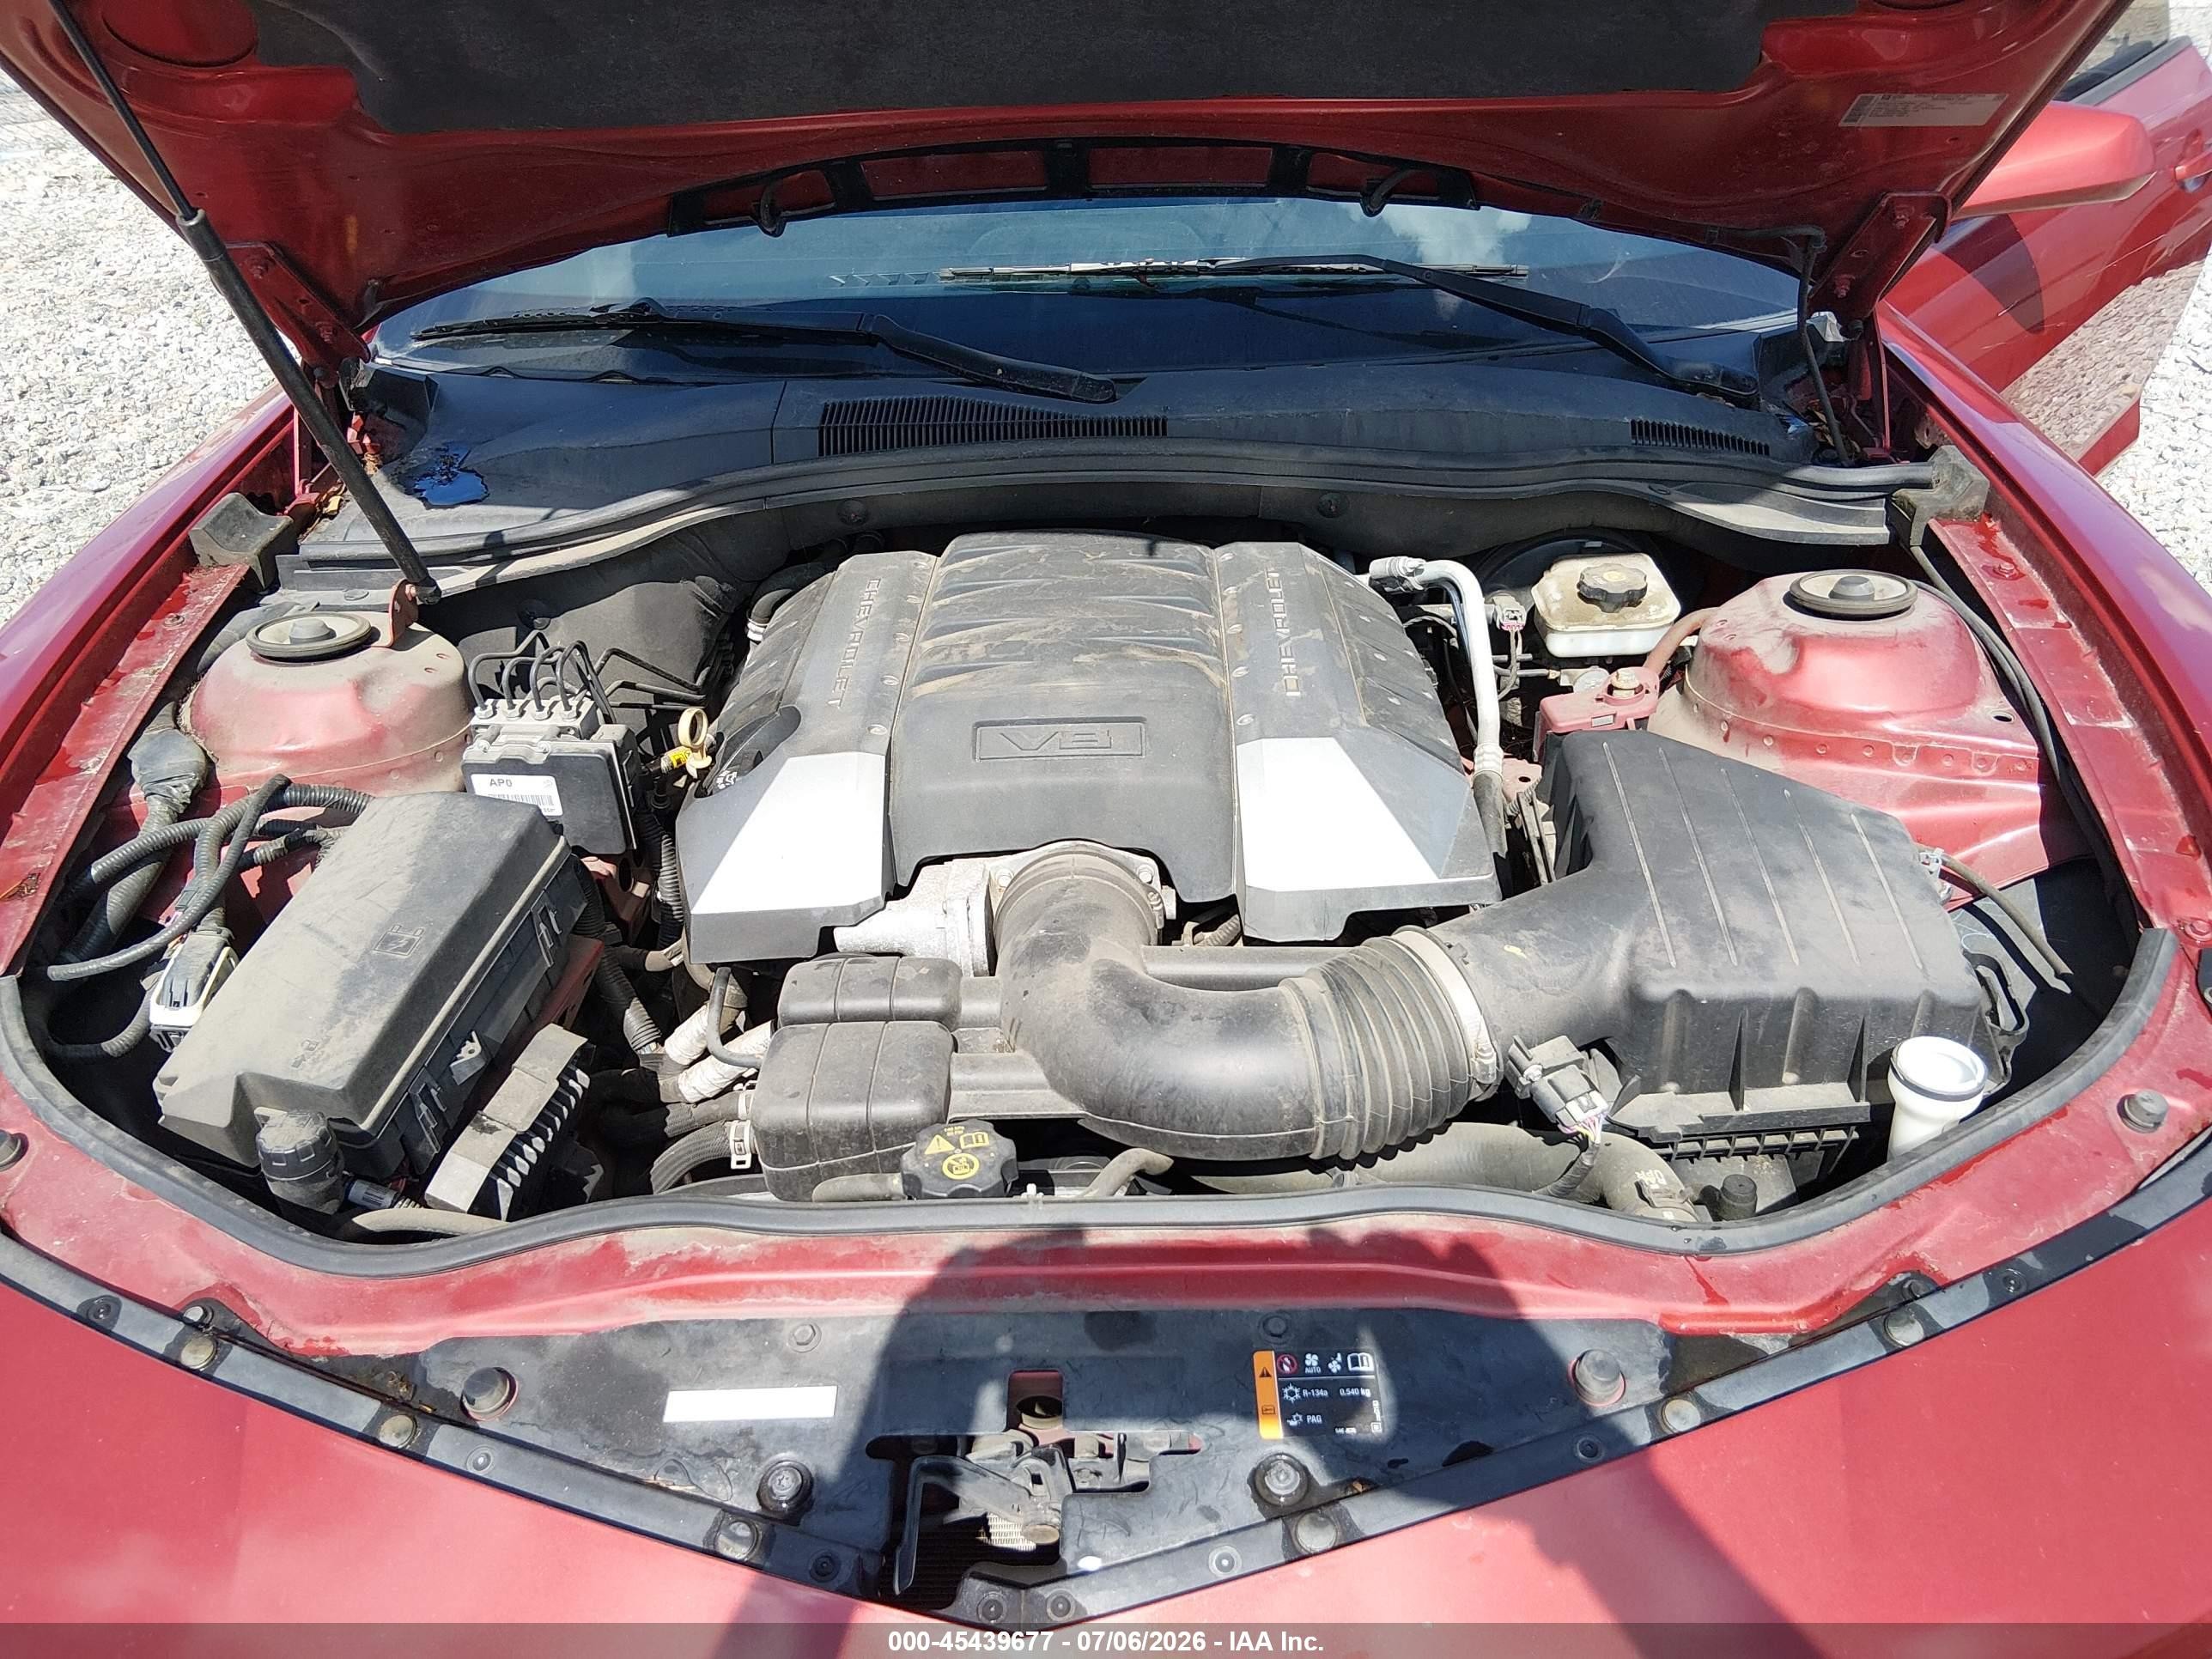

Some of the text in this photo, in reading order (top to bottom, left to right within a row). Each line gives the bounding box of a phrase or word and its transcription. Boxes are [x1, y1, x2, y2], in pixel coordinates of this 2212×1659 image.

[1264, 568, 1301, 696] CHEVROLET
[827, 578, 881, 709] CHEVROLET
[999, 729, 1112, 751] V8
[1302, 1387, 1371, 1398] R-134a 0.540 kg
[1306, 1414, 1323, 1424] PAG
